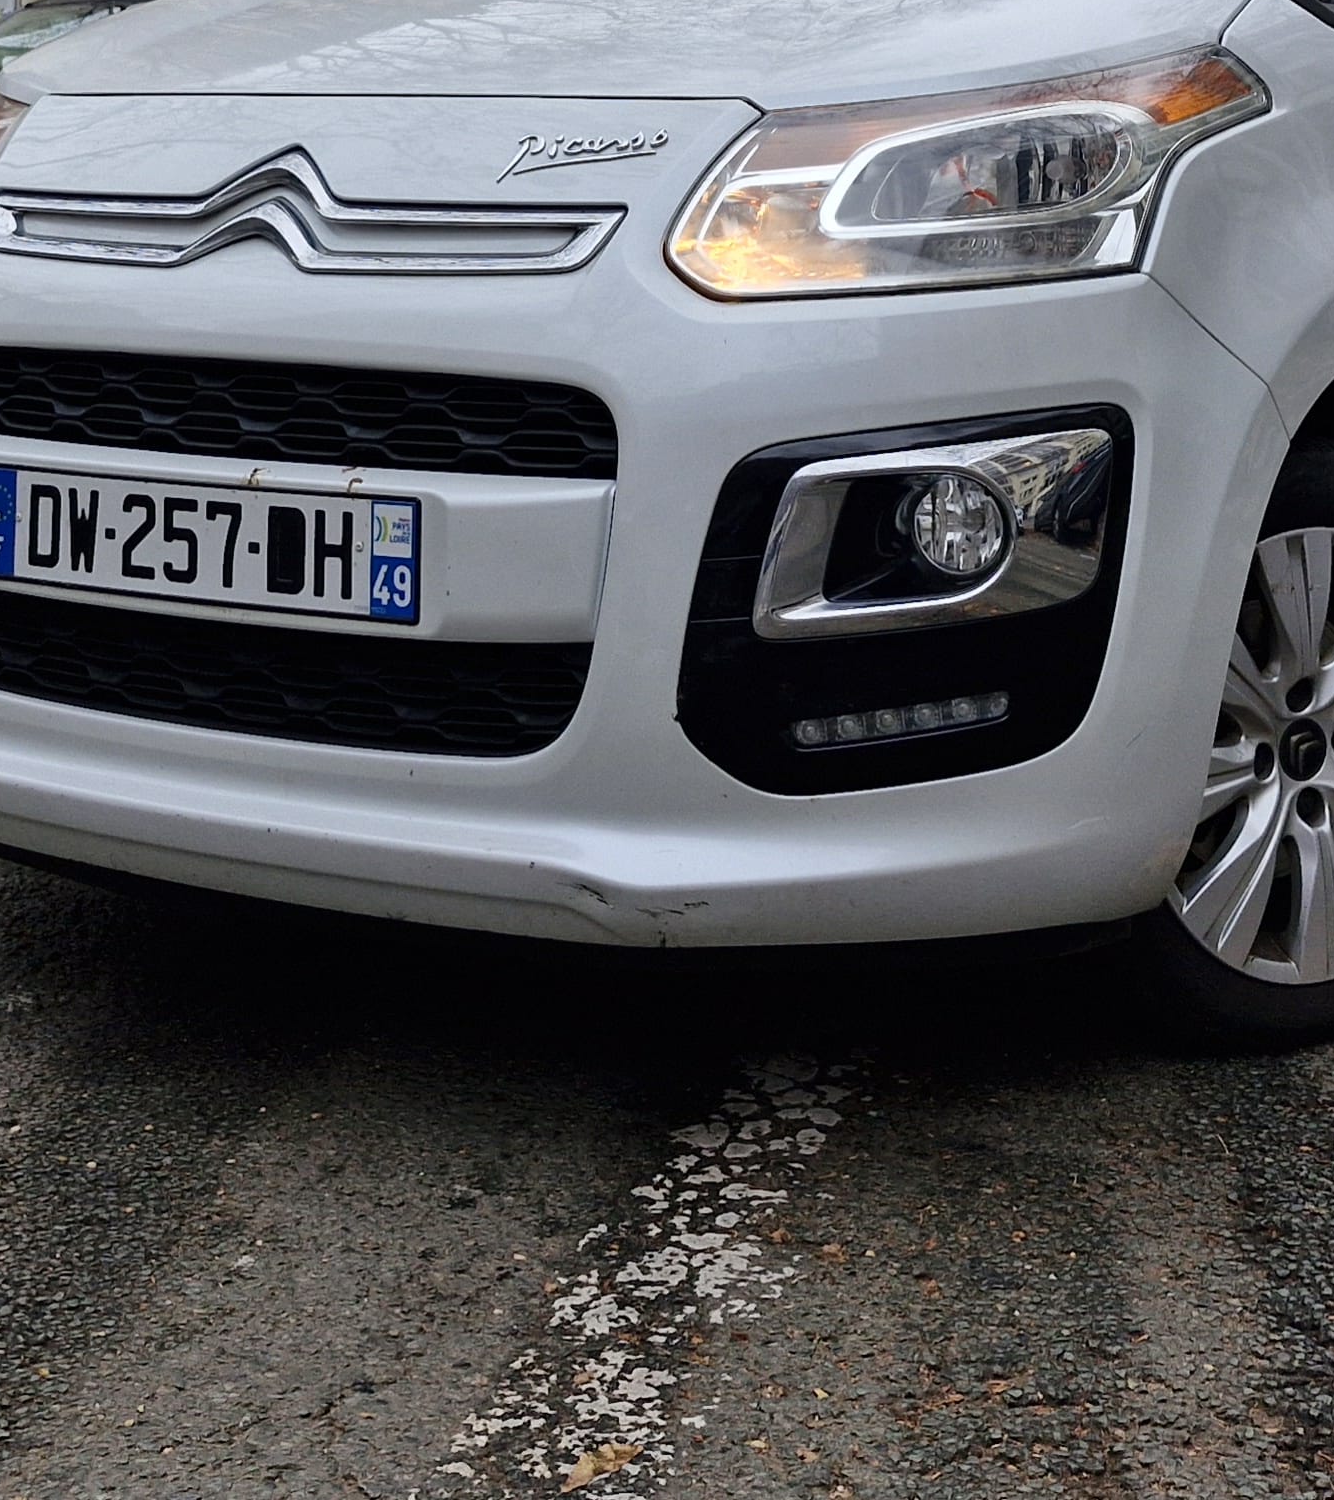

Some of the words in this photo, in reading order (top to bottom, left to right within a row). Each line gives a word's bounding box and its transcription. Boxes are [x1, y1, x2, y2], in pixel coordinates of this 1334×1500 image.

[496, 128, 669, 184] Picasso
[389, 534, 411, 545] LOIRE
[391, 521, 411, 532] PAYS
[372, 564, 413, 608] 49
